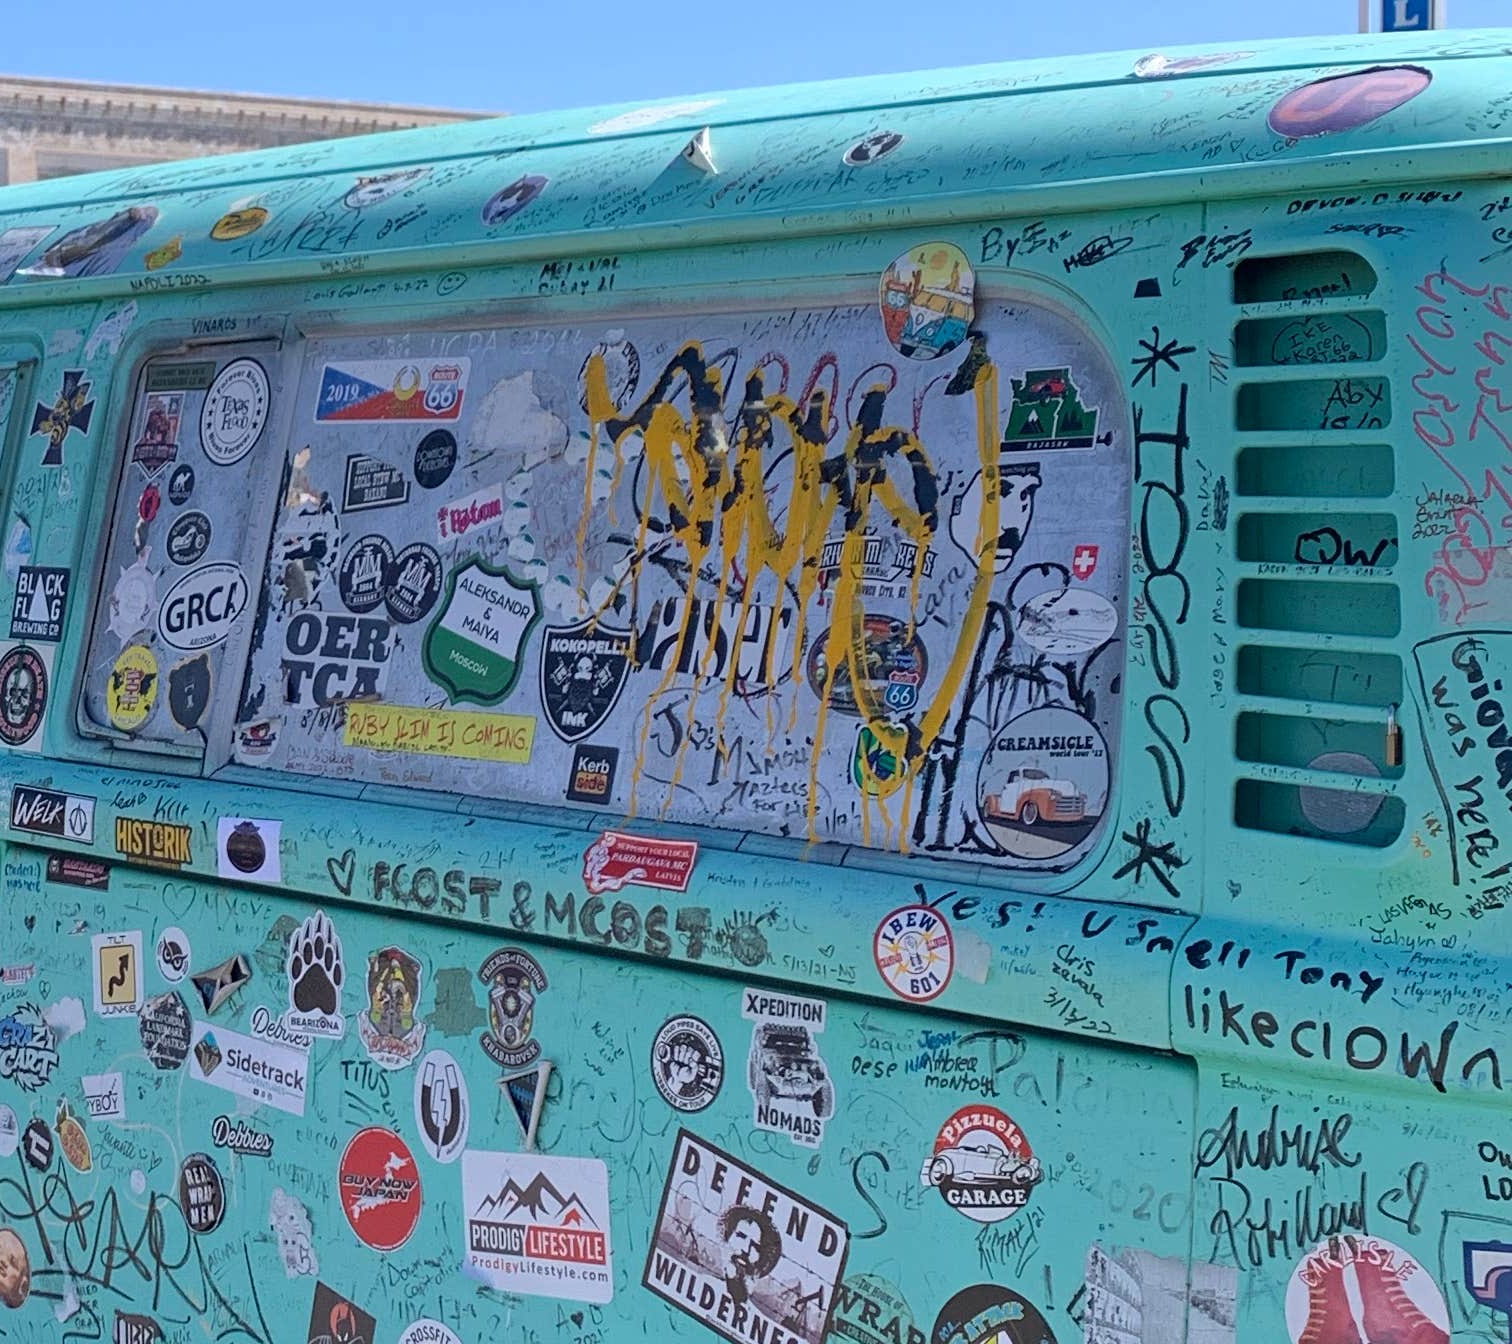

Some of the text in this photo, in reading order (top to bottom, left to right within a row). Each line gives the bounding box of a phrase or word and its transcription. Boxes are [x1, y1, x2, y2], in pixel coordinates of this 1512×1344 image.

[326, 383, 360, 402] 2019
[427, 384, 454, 407] 66
[164, 581, 239, 634] GRCA
[460, 578, 531, 619] ALEKSANDR
[483, 607, 492, 621] &
[13, 621, 47, 635] BREWING
[462, 615, 500, 644] MAIYA
[890, 687, 910, 704] 66
[561, 712, 589, 728] INK
[997, 736, 1094, 752] CREAMSICLE
[1049, 750, 1072, 758] world
[578, 757, 610, 774] Kerb
[116, 819, 192, 864] HISTORIK
[669, 859, 687, 871] MC
[884, 912, 938, 944] IBEW
[910, 974, 942, 995] 601
[1275, 952, 1383, 1003] Tony
[746, 993, 823, 1023] XPEDITION
[290, 1017, 340, 1031] BEARIZONA
[482, 1036, 539, 1065] KHABAROVSK
[226, 1049, 305, 1091] Sidetrack
[214, 1118, 273, 1150] Debbies
[757, 1104, 821, 1137] NOMADS
[942, 1113, 1023, 1148] Pizzuela
[343, 1174, 416, 1190] BUY NOW
[354, 1185, 410, 1201] JAPAN
[683, 1144, 839, 1258] DEFEND
[946, 1188, 1027, 1206] GARAGE
[471, 1223, 604, 1261] PRODIGY LIFESTYLE
[471, 1256, 609, 1283] ProdigyLifestyle.com
[1298, 1239, 1418, 1288] CARLISLE
